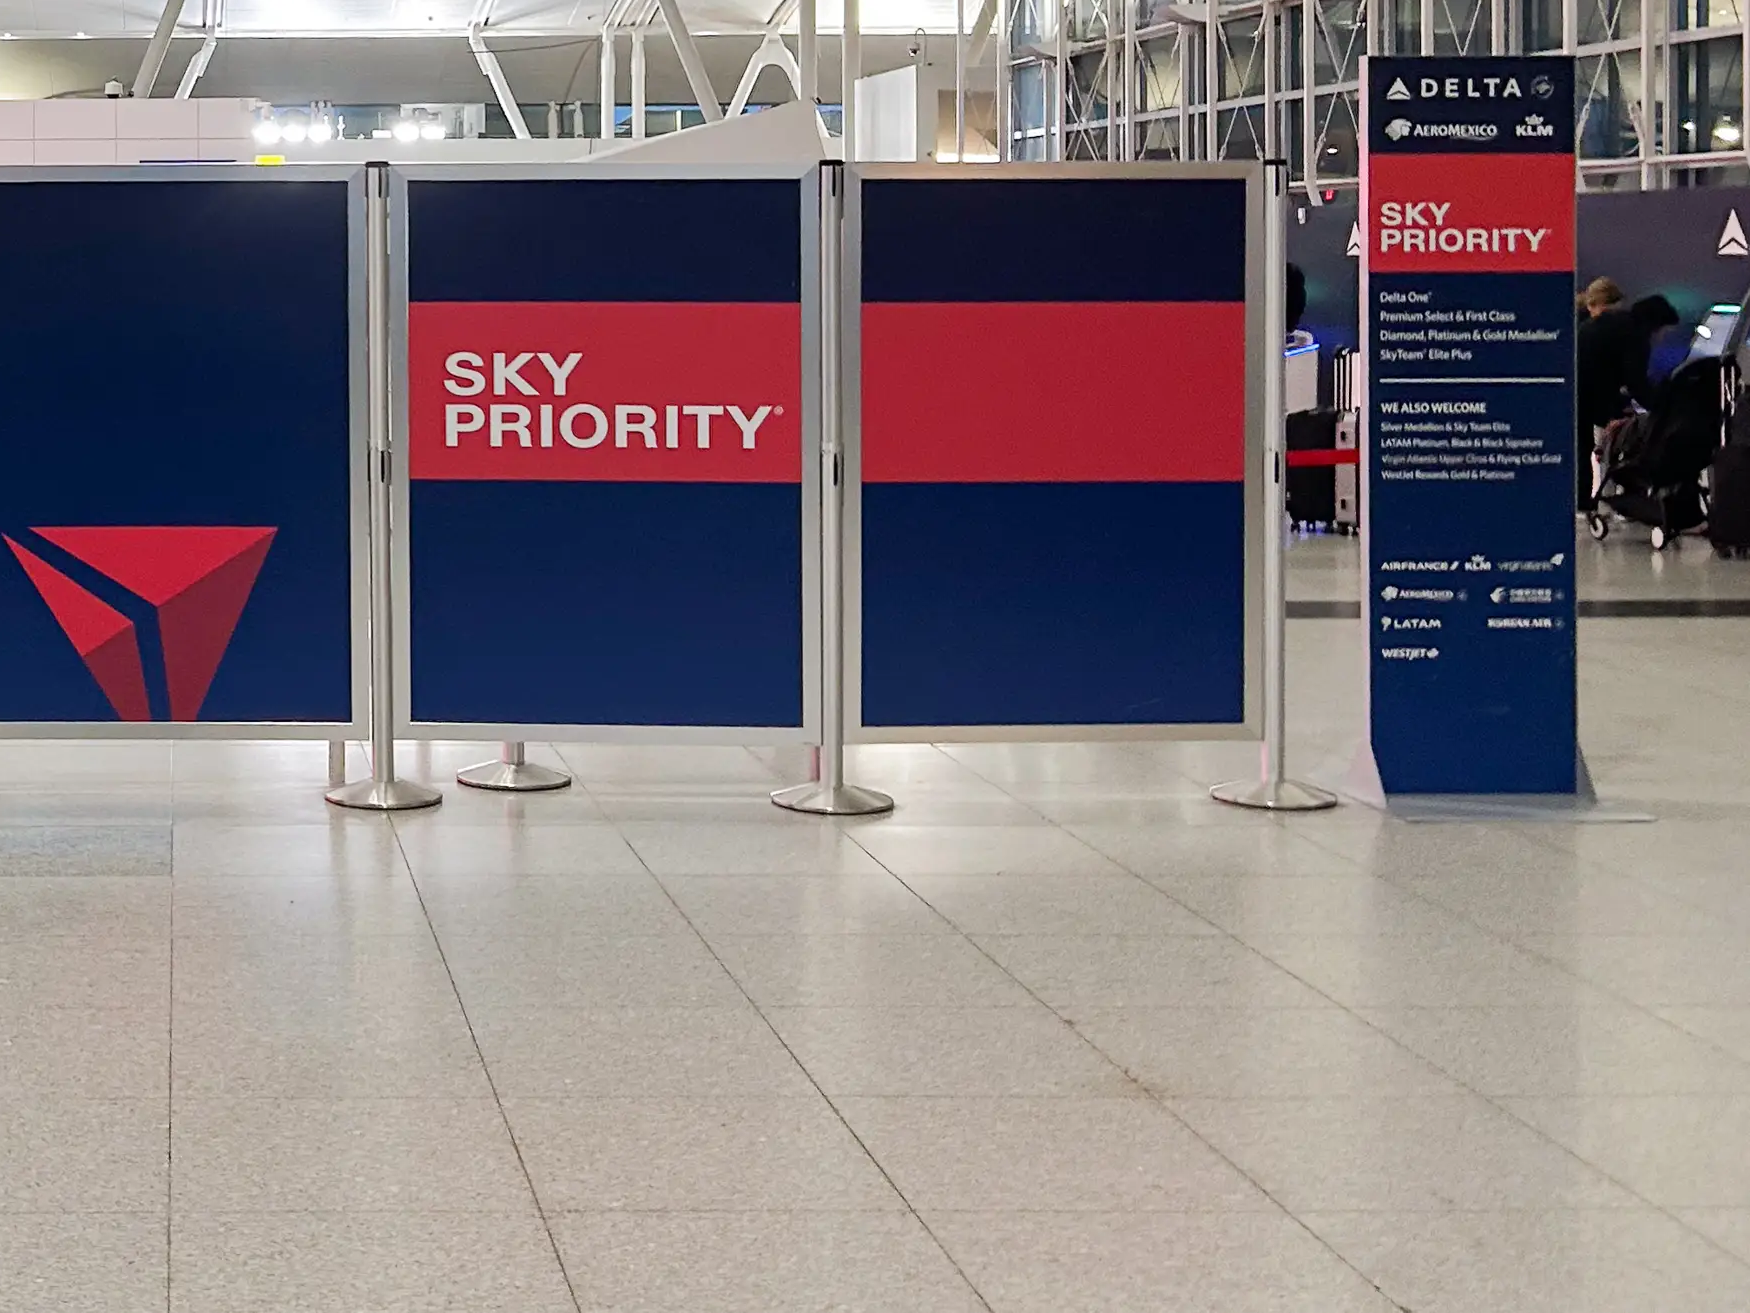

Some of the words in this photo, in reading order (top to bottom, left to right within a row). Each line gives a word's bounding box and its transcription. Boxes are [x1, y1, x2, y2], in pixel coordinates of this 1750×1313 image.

[1419, 77, 1523, 98] DELTA
[1515, 124, 1553, 137] KLM
[1380, 201, 1451, 226] SKY
[1379, 291, 1406, 303] Delta
[1379, 310, 1423, 322] Premium
[1424, 310, 1454, 322] Select
[1455, 310, 1464, 322] &
[1466, 310, 1487, 322] First
[1488, 310, 1516, 322] Class
[1428, 329, 1471, 342] Platinum
[1472, 329, 1481, 342] &
[1483, 329, 1506, 342] Gold
[1428, 348, 1450, 362] Elite
[1451, 348, 1473, 362] Plus
[443, 351, 584, 397] SKY
[1380, 401, 1399, 414] WE
[1400, 401, 1430, 414] ALSO
[1431, 401, 1487, 414] WELCOME
[1380, 421, 1403, 433] Silver
[1380, 438, 1412, 449] LATAM
[1464, 561, 1492, 571] KLM
[1393, 618, 1442, 629] LATAM
[1381, 647, 1427, 661] WESTJET
